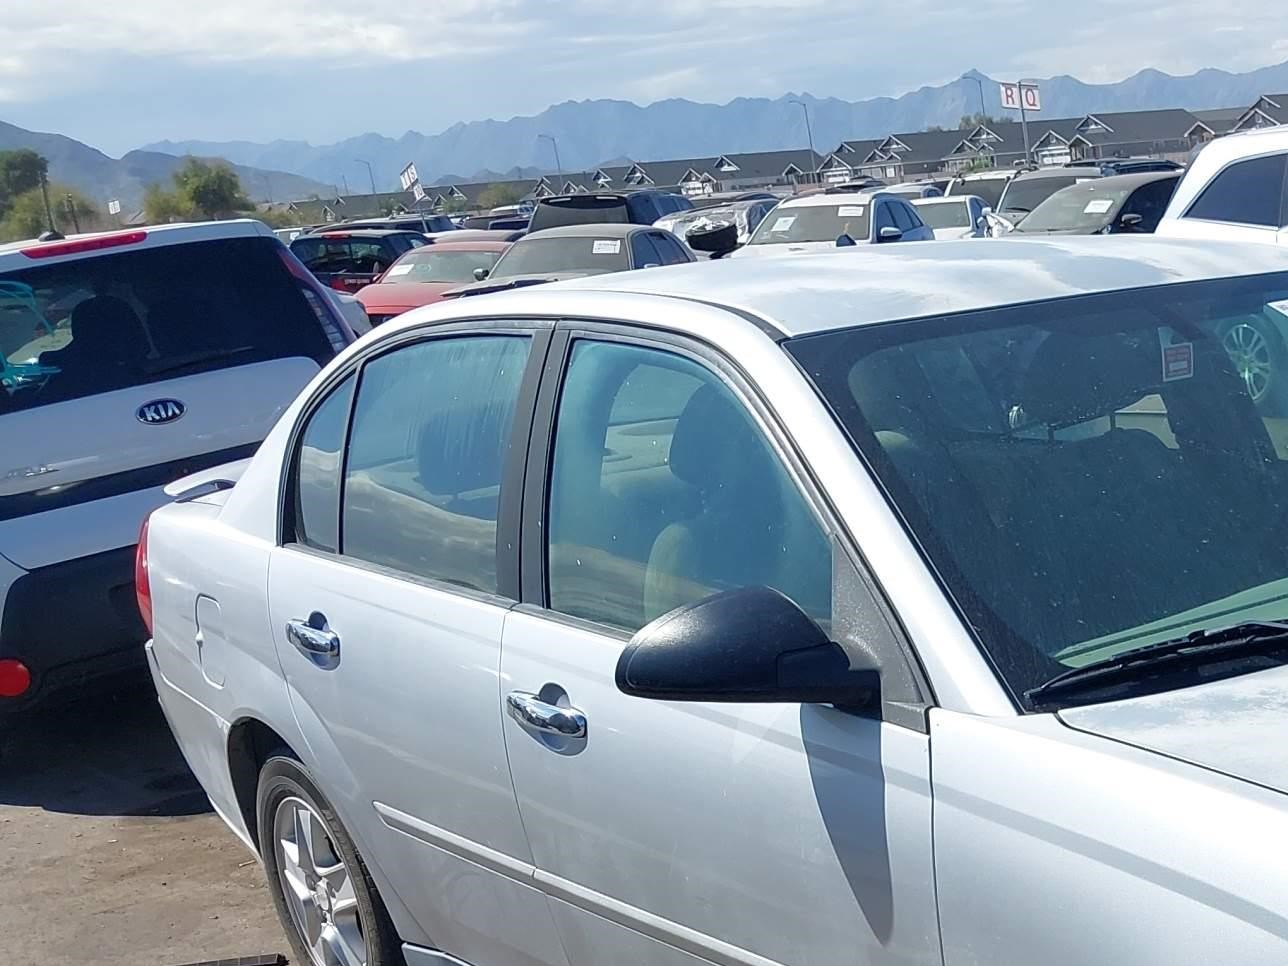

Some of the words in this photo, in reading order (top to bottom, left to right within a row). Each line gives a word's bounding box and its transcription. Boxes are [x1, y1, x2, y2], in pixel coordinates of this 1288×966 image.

[1005, 87, 1014, 105] R
[1025, 88, 1037, 107] Q
[143, 401, 180, 421] KIA
